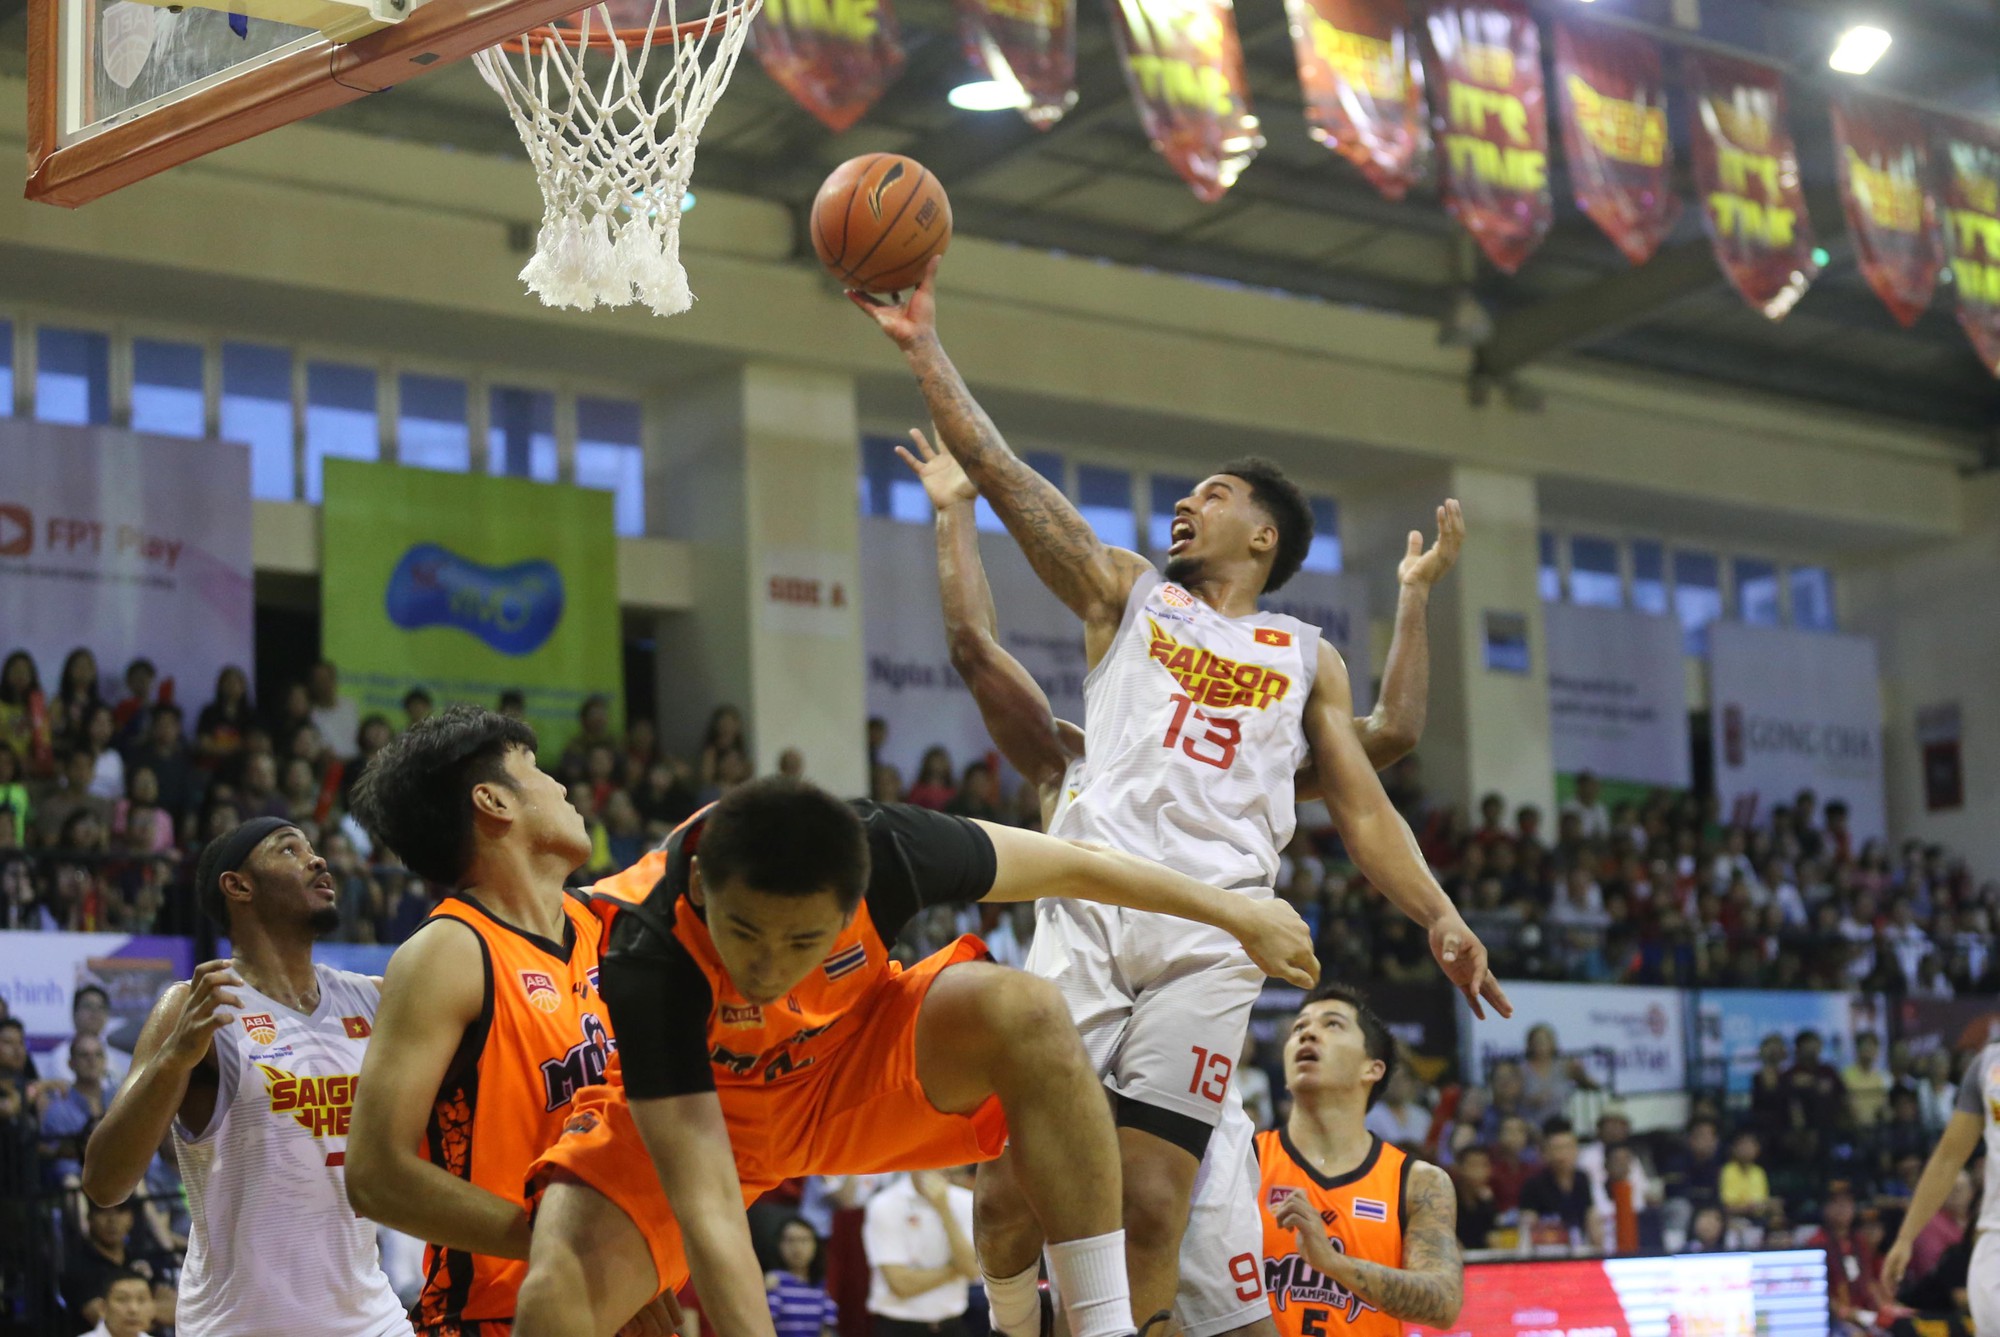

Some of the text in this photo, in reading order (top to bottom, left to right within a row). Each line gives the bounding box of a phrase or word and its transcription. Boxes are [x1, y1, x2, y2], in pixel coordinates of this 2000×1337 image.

[47, 518, 103, 554] FPT
[1149, 638, 1291, 703] SAIGON
[1163, 693, 1242, 770] 13
[526, 975, 554, 988] ABL
[245, 1015, 273, 1027] ABL
[1189, 1045, 1232, 1104] 13
[270, 1074, 360, 1113] SAIG
[312, 1106, 353, 1138] HE
[1228, 1252, 1263, 1302] 9
[1291, 1288, 1346, 1307] VAMPIRE
